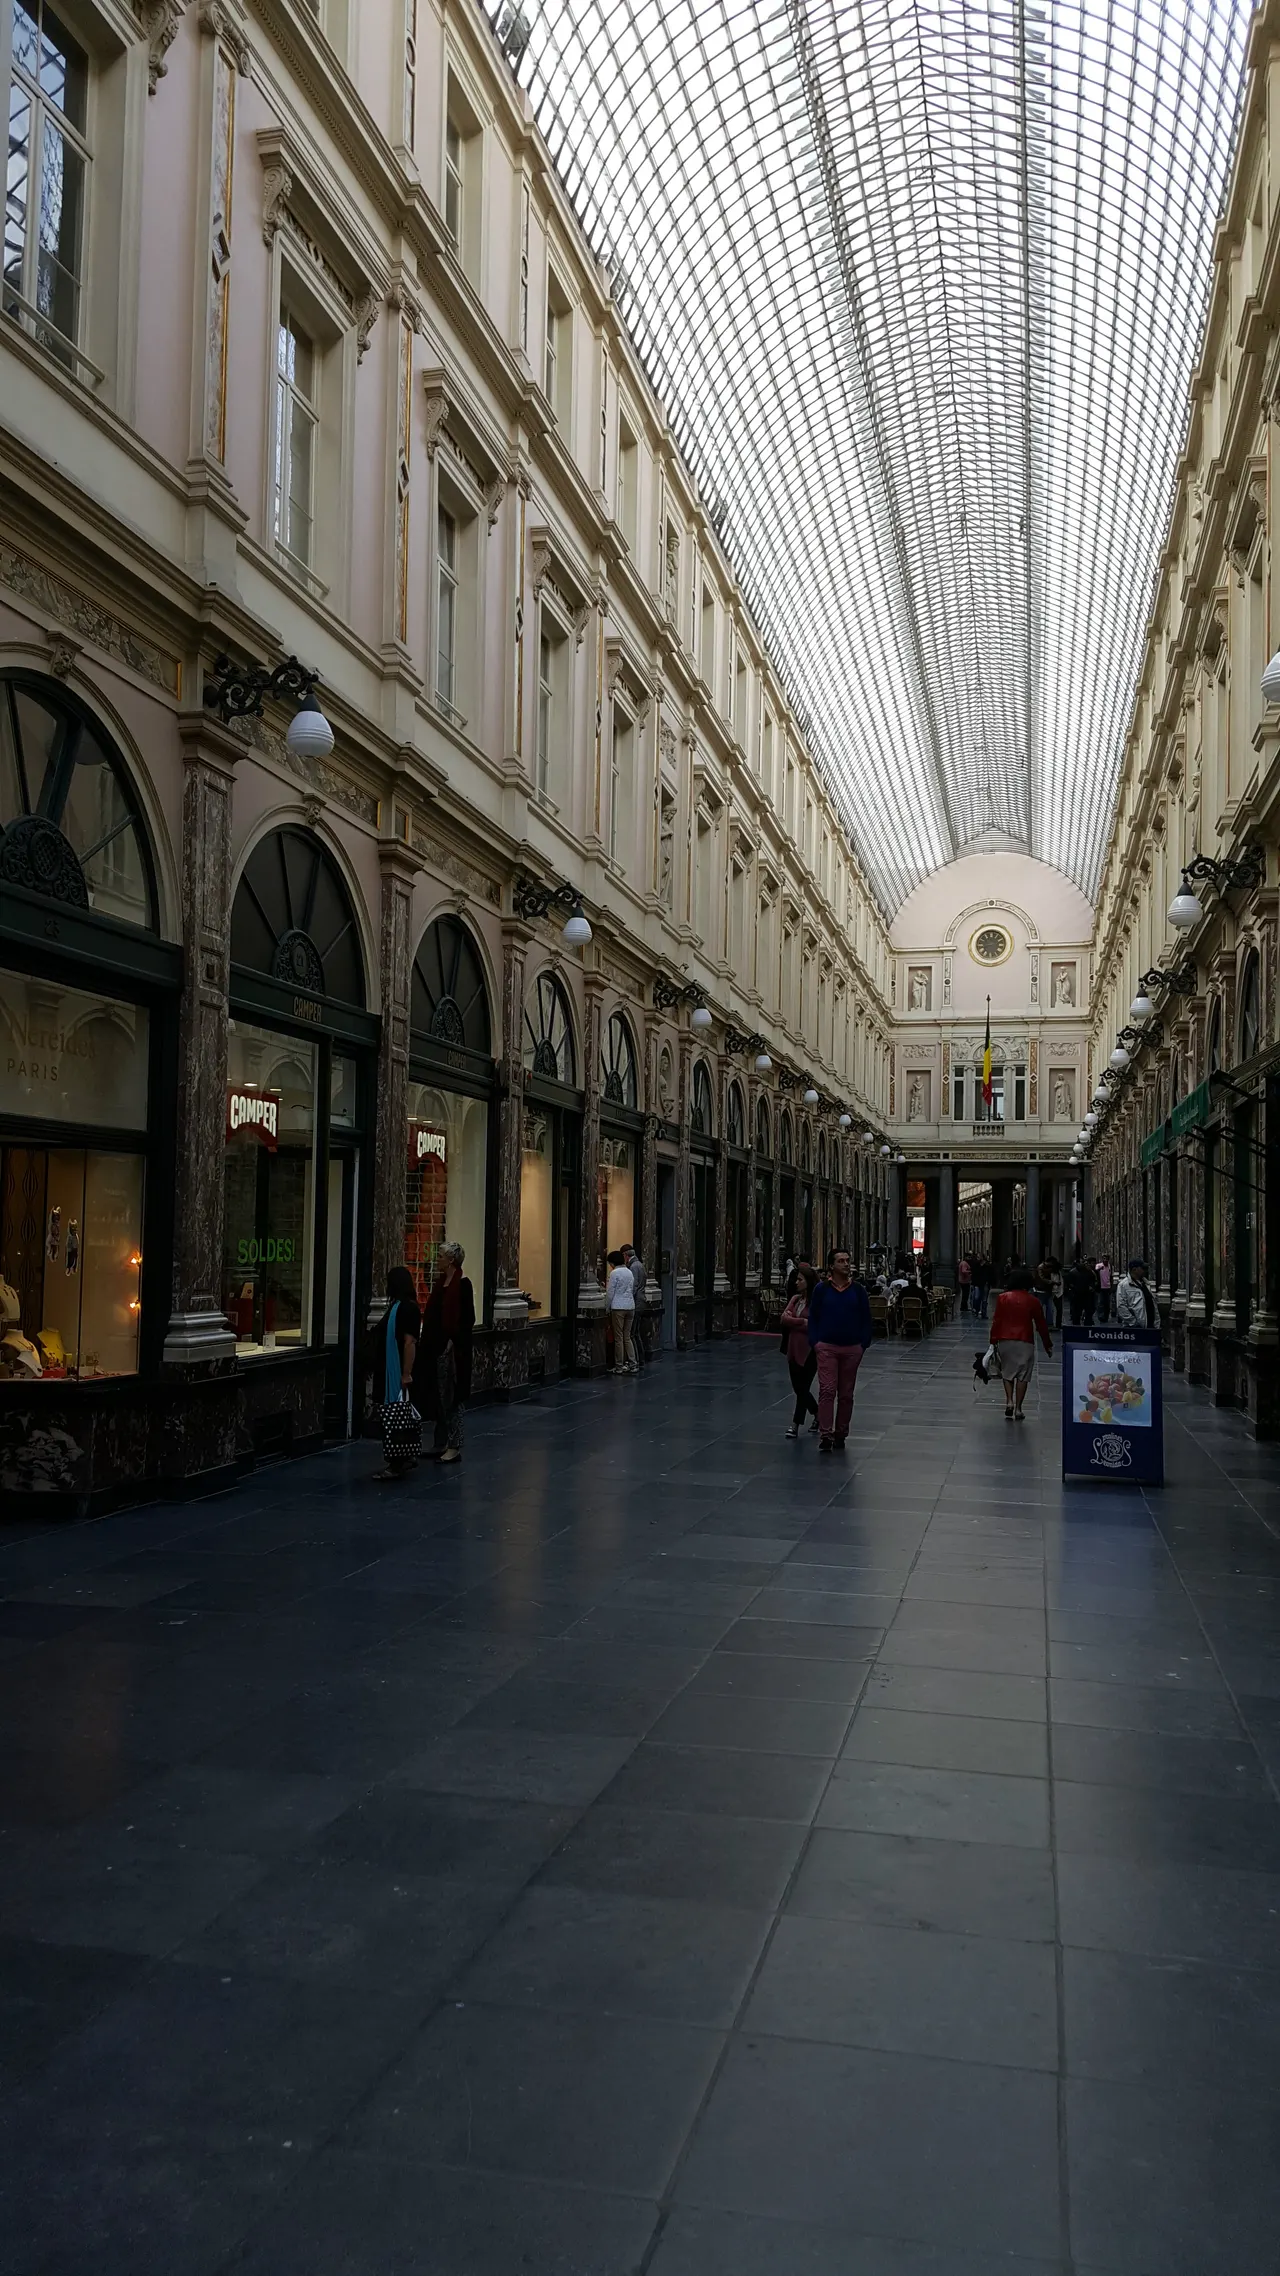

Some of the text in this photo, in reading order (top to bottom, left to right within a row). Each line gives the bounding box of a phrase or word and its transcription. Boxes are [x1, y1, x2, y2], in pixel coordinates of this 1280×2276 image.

[294, 996, 322, 1023] CAMPER
[7, 1058, 58, 1081] PARIS
[230, 1094, 277, 1138] CAMPER
[417, 1131, 446, 1163] CAMPER
[237, 1238, 296, 1265] SOLDES!
[1088, 1330, 1136, 1341] Leonidas
